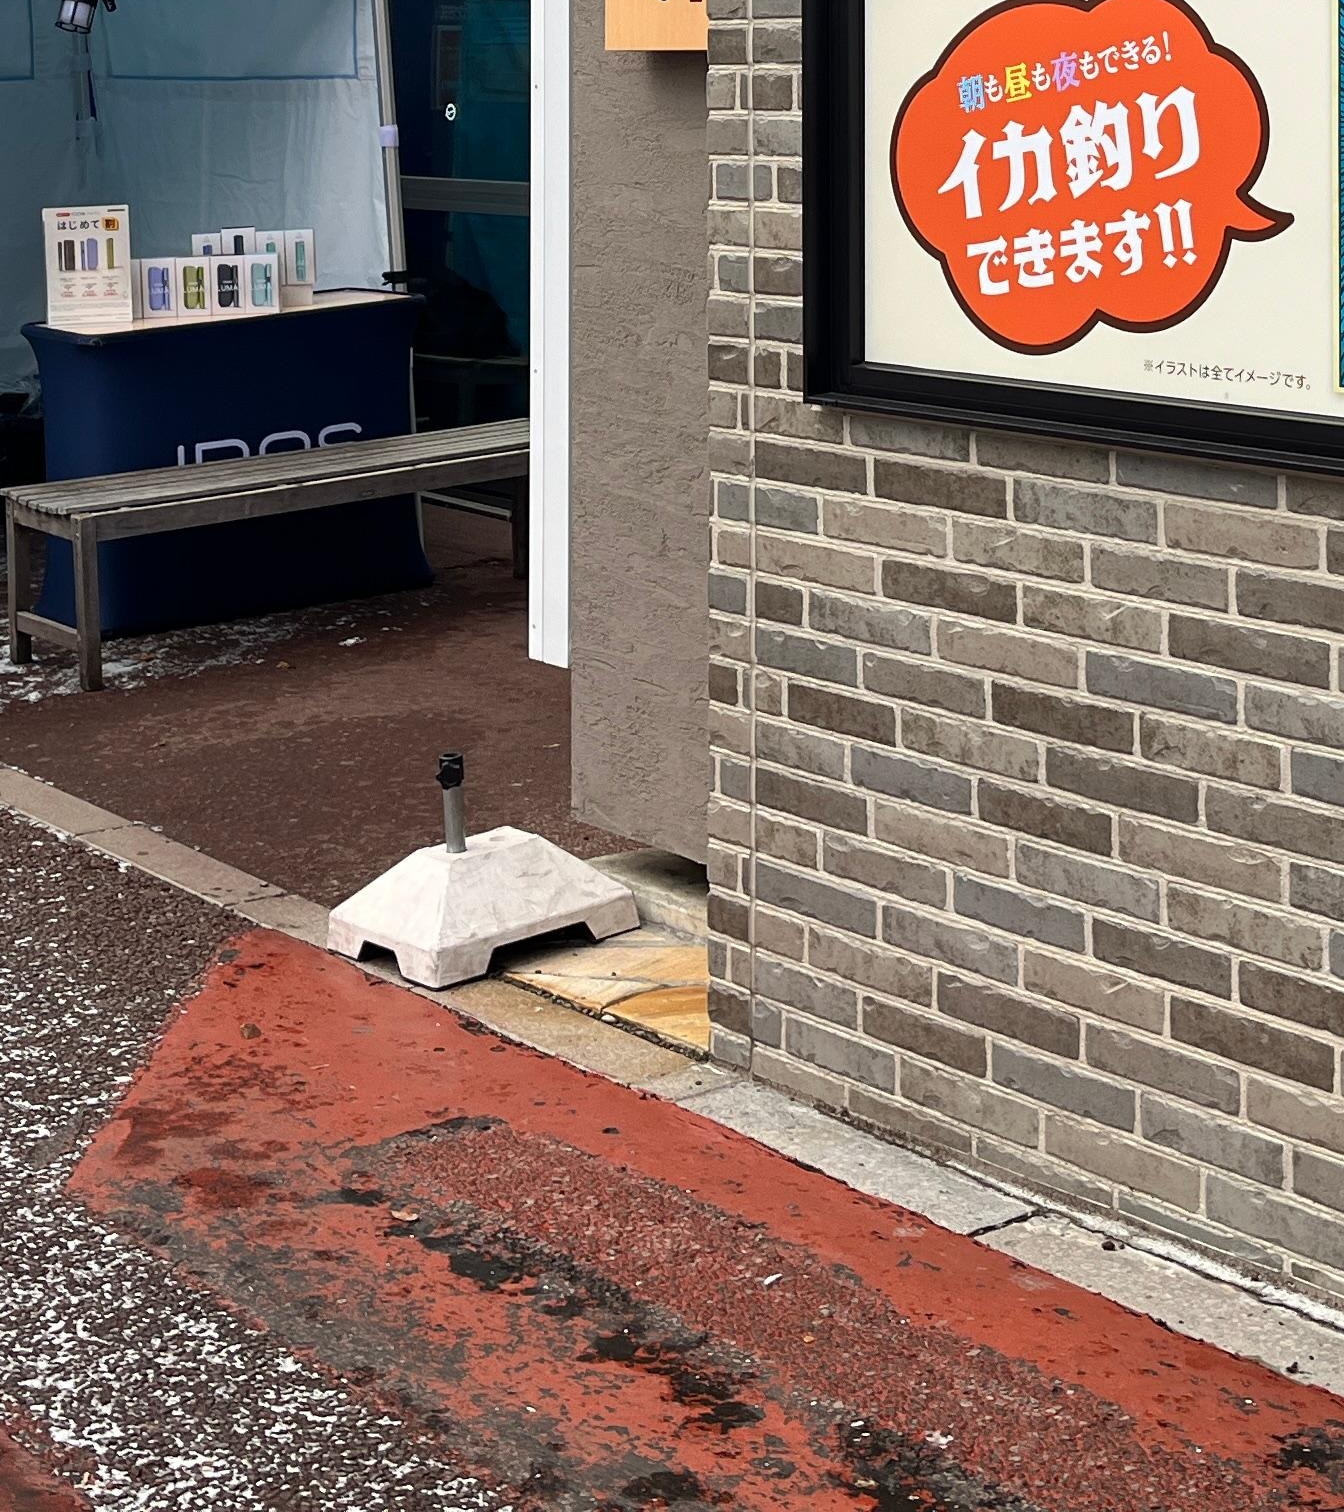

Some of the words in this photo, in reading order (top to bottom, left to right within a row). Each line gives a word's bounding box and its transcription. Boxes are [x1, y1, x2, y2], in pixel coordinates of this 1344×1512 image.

[956, 30, 1173, 114] 朝も昼も夜もできる!
[937, 85, 1201, 220] イカ釣り
[966, 198, 1198, 296] できます!!
[1143, 359, 1312, 391] ※イラストは全てイメージです。
